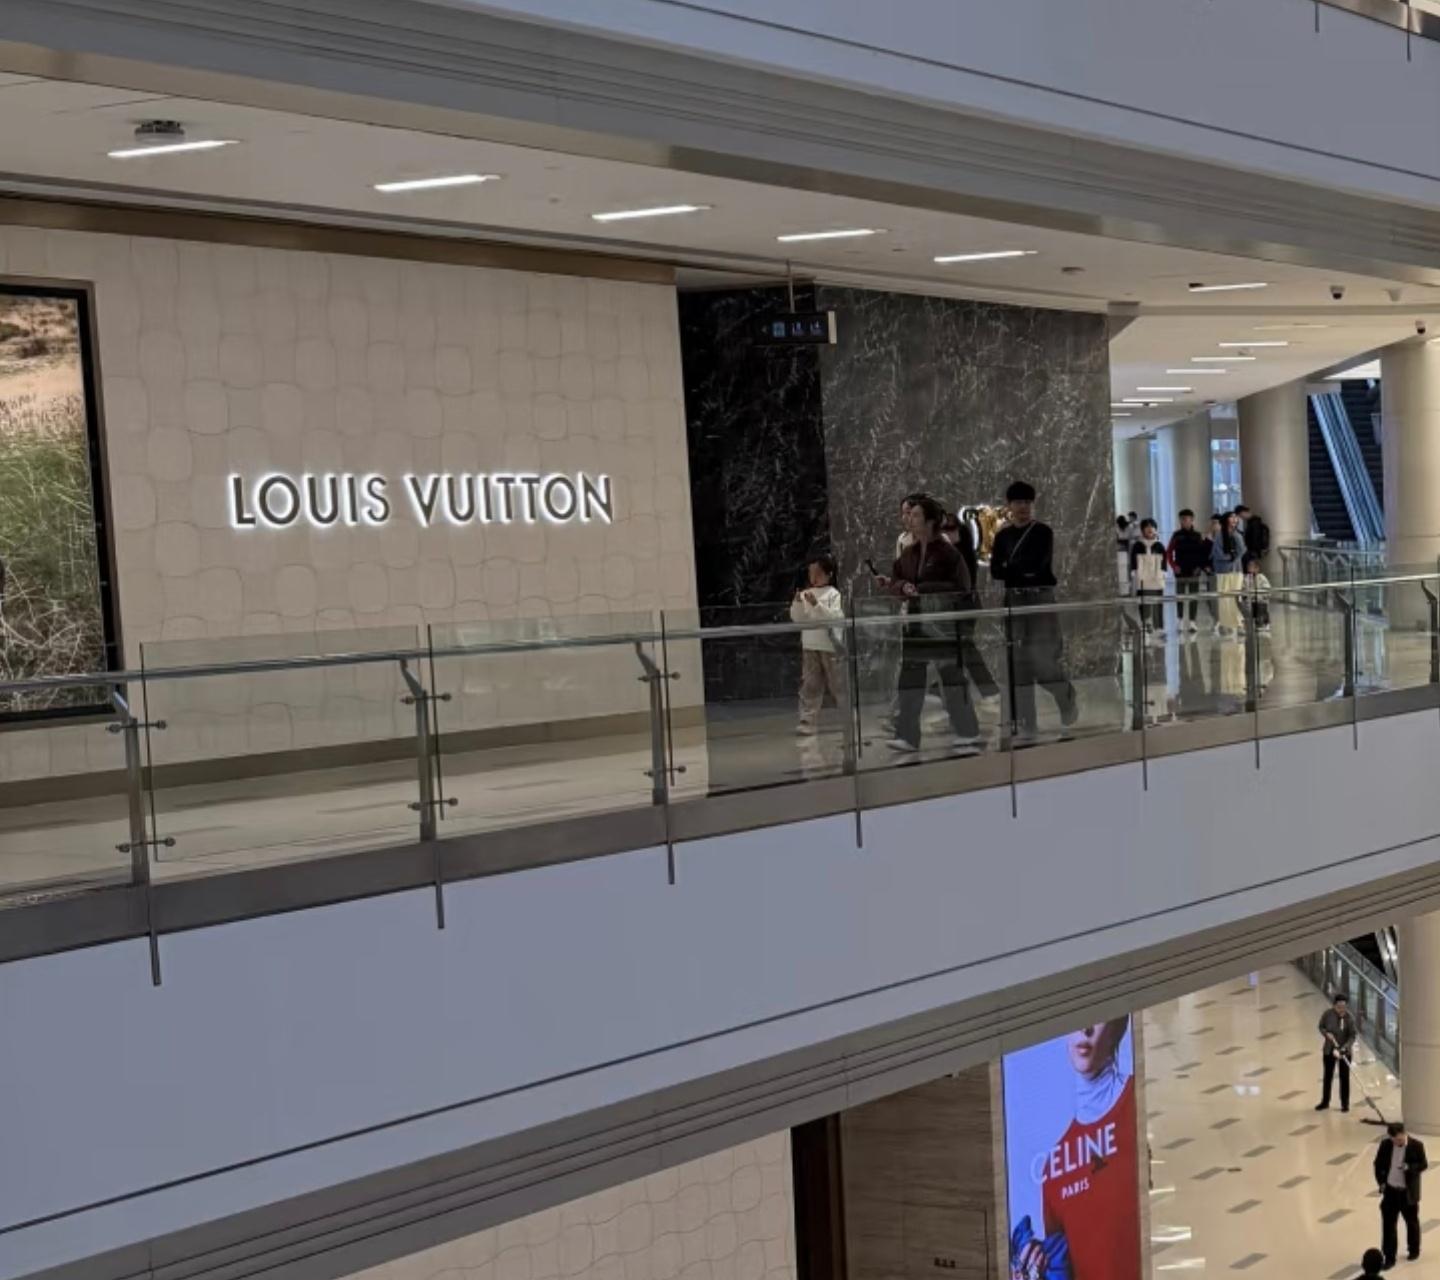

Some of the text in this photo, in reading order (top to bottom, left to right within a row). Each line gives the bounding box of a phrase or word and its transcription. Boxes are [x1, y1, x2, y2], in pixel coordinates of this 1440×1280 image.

[229, 471, 614, 528] LOUIS VUITTON
[1030, 1122, 1118, 1185] CELINE
[1061, 1177, 1090, 1200] PARIS
